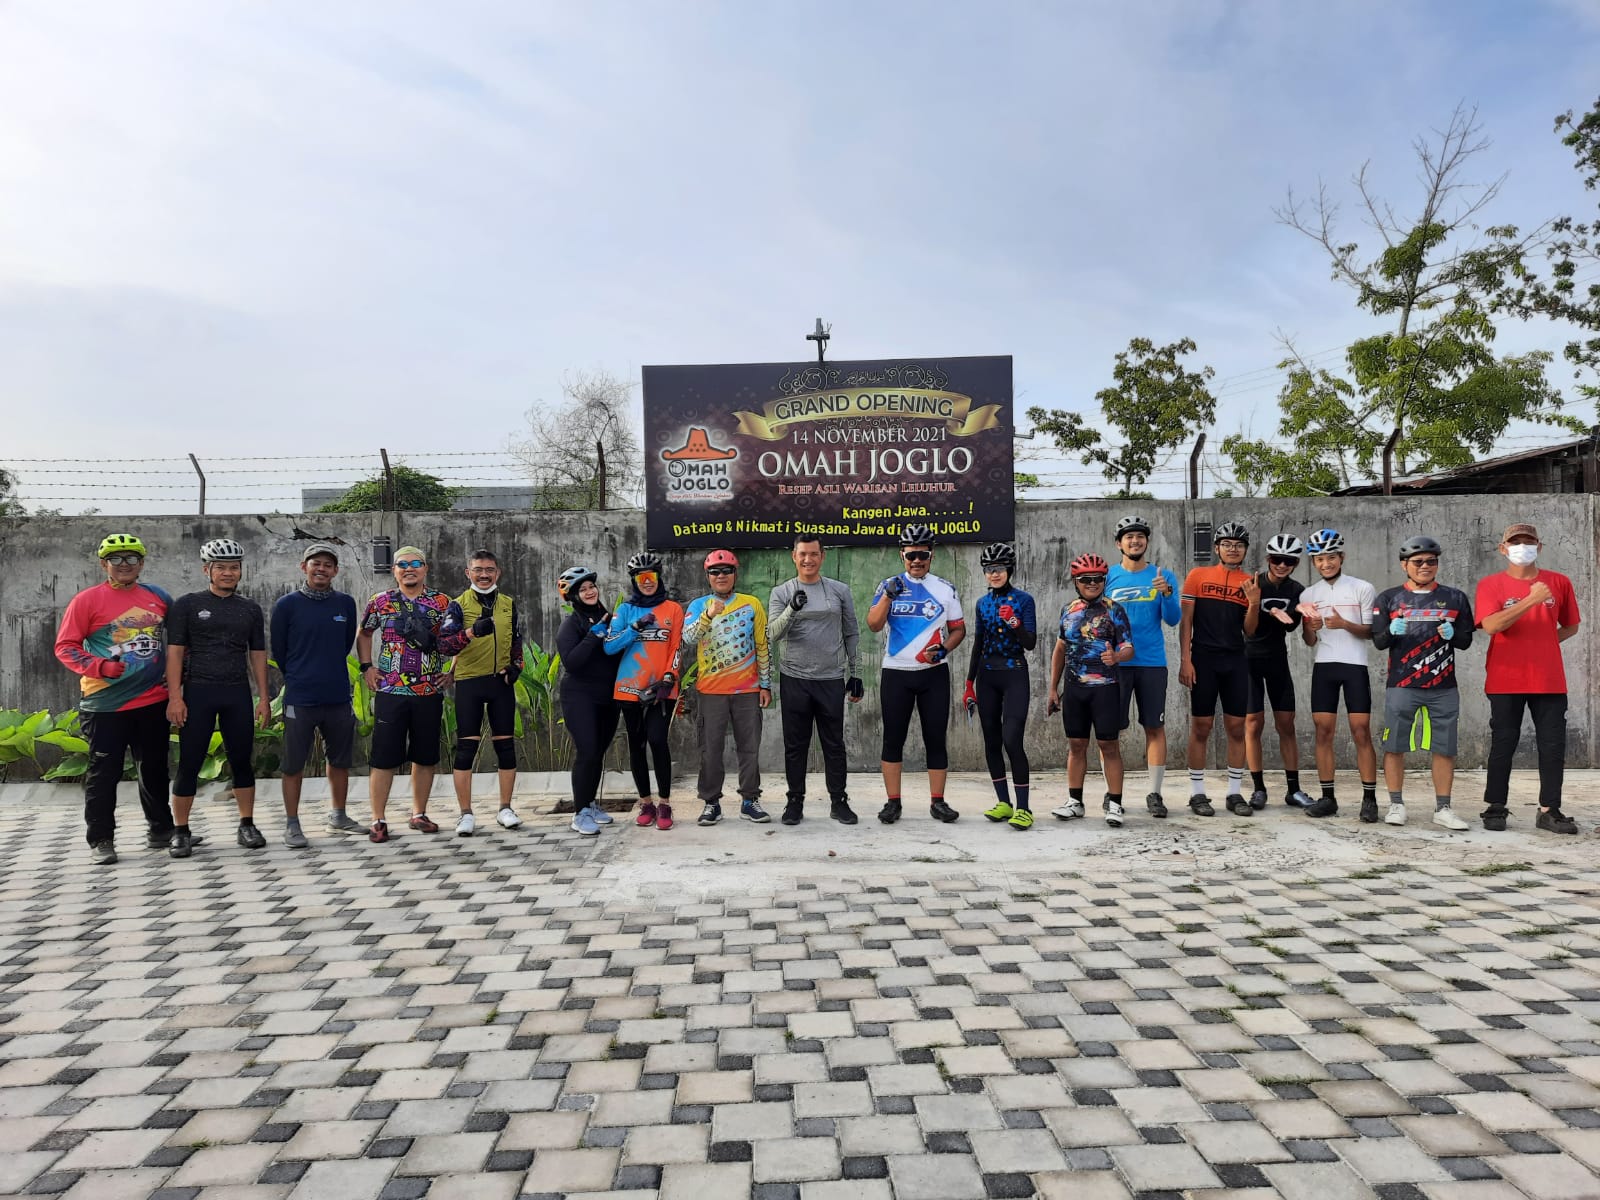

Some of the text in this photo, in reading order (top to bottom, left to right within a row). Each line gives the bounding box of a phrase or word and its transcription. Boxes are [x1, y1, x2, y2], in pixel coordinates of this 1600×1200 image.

[775, 394, 953, 420] GRAND OPENING
[792, 427, 946, 444] 14 NOVEMBER 2021
[757, 446, 973, 482] OMAH JOGLO
[671, 478, 730, 490] JOGLO
[842, 507, 892, 519] Kangen
[673, 522, 723, 537] Datang
[726, 520, 733, 532] &
[736, 520, 790, 533] Nikmati
[794, 522, 850, 535] Suasana
[852, 523, 885, 535] Jawa
[887, 523, 901, 535] di
[940, 520, 981, 535] JOGLO
[893, 603, 917, 613] FDJ
[1412, 643, 1450, 671] YETI
